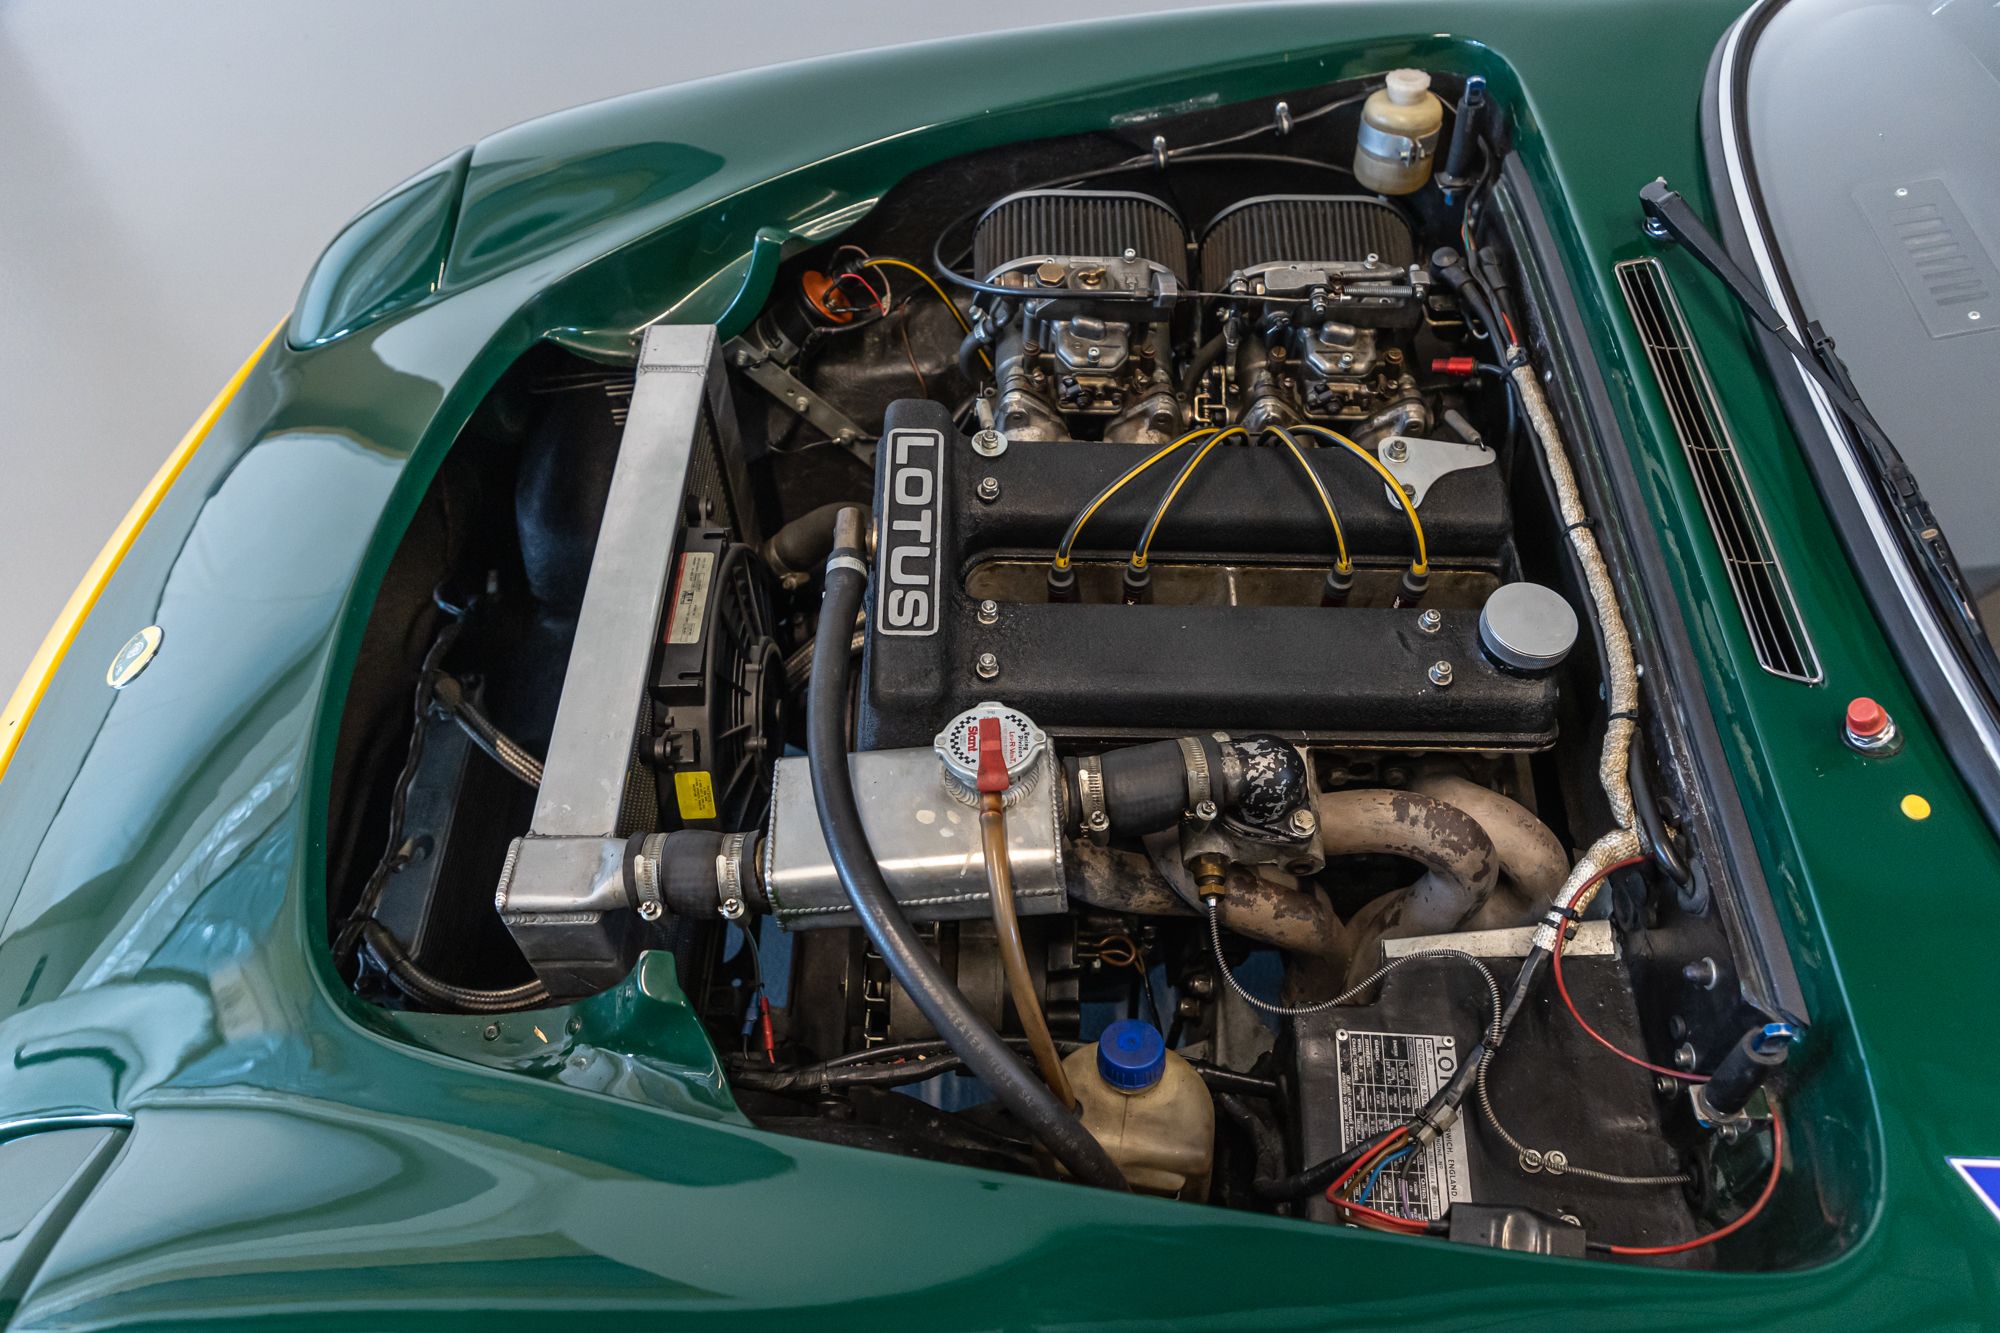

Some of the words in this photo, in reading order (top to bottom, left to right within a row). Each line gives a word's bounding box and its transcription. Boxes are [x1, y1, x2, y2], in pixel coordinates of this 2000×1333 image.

[887, 436, 935, 627] LOTUS
[967, 725, 979, 752] Stant
[1417, 1044, 1427, 1087] RECOMMENDED
[1425, 1040, 1433, 1054] UNIT
[1447, 1159, 1458, 1199] ENGLAND.
